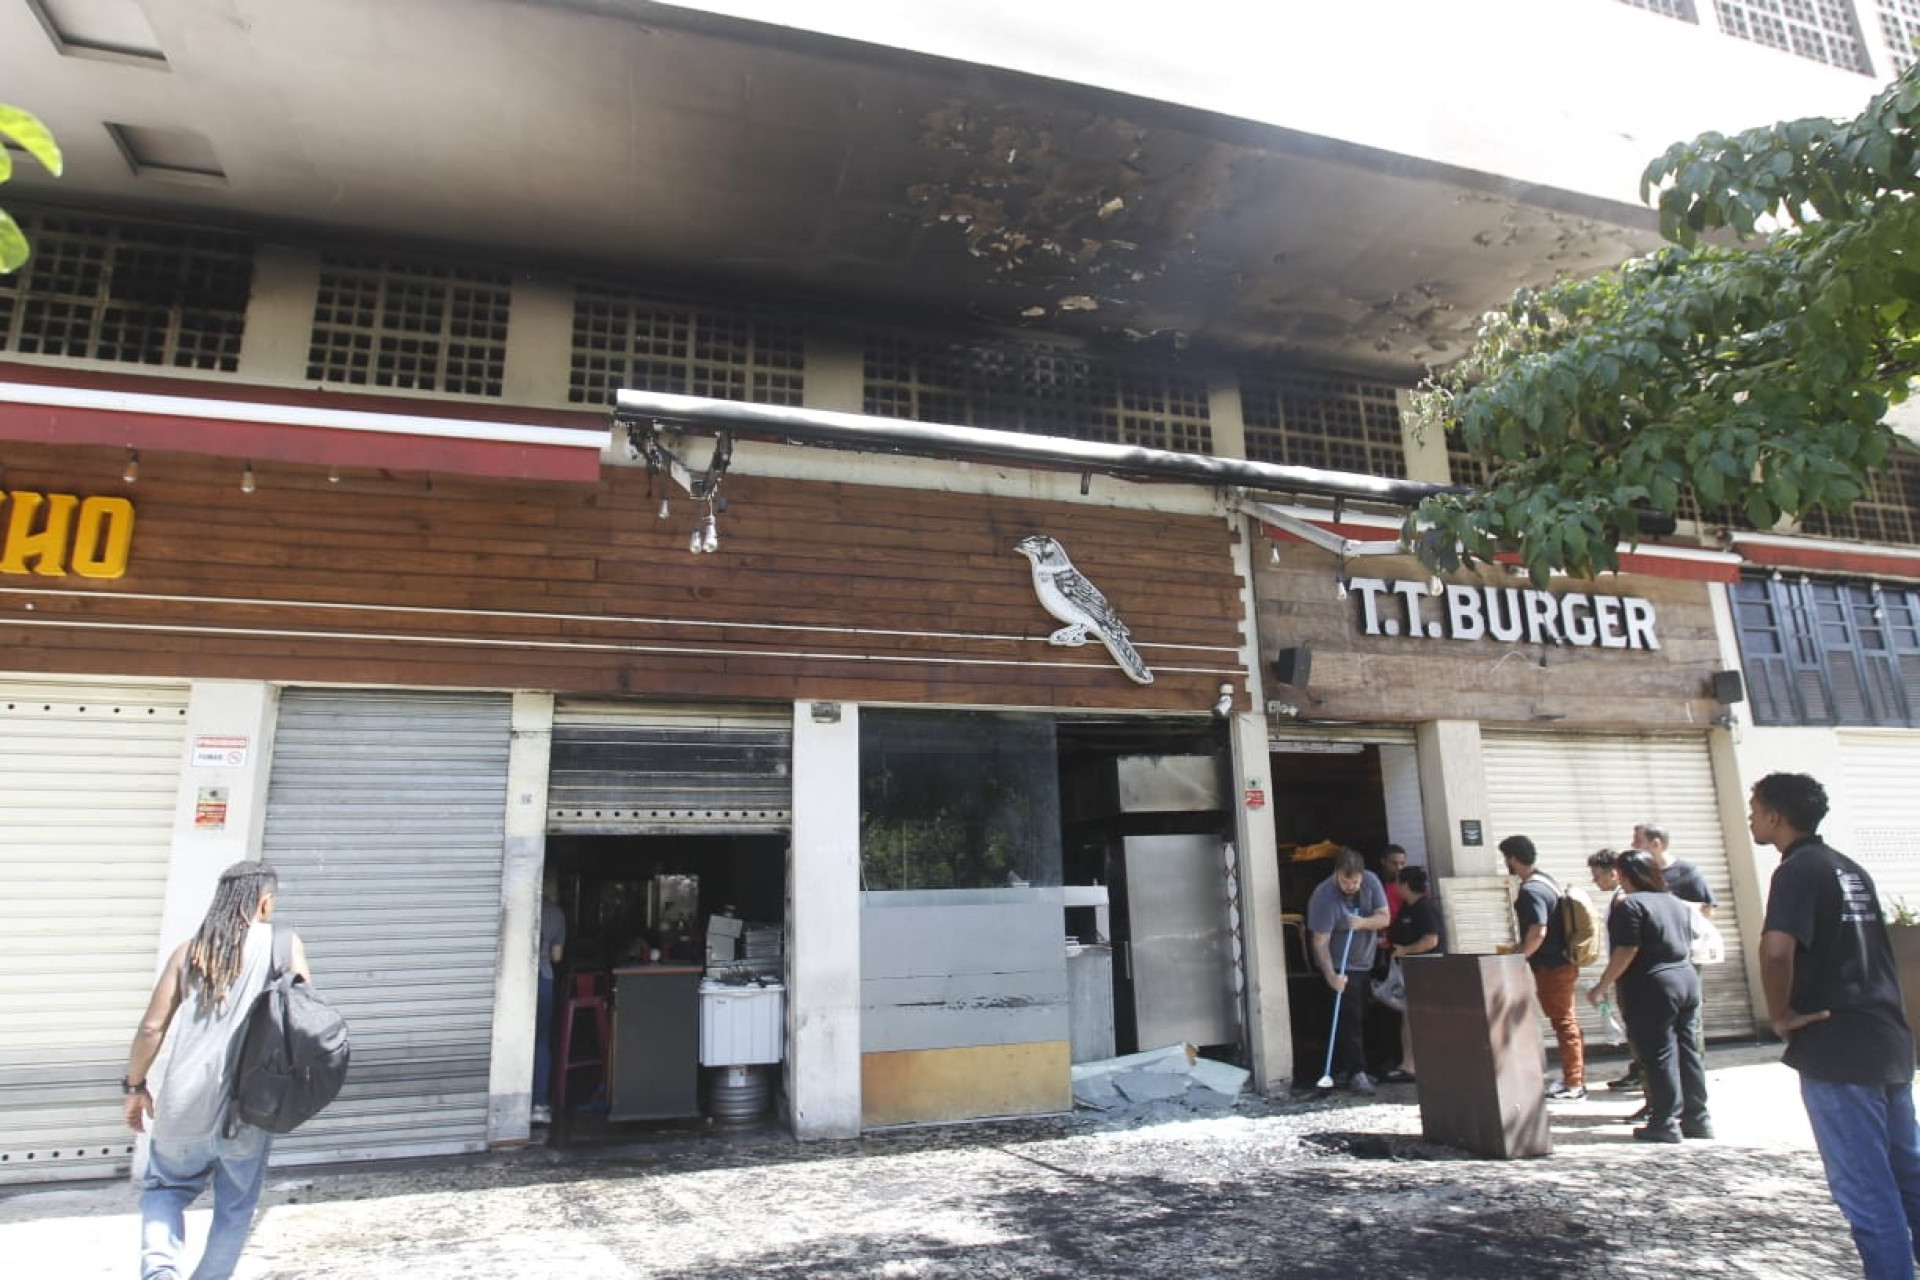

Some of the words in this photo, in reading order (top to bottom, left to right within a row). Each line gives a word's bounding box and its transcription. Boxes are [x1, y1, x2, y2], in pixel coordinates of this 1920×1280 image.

[0, 490, 136, 578] HO
[1349, 576, 1443, 639] T.T.
[1446, 584, 1661, 650] BURGER
